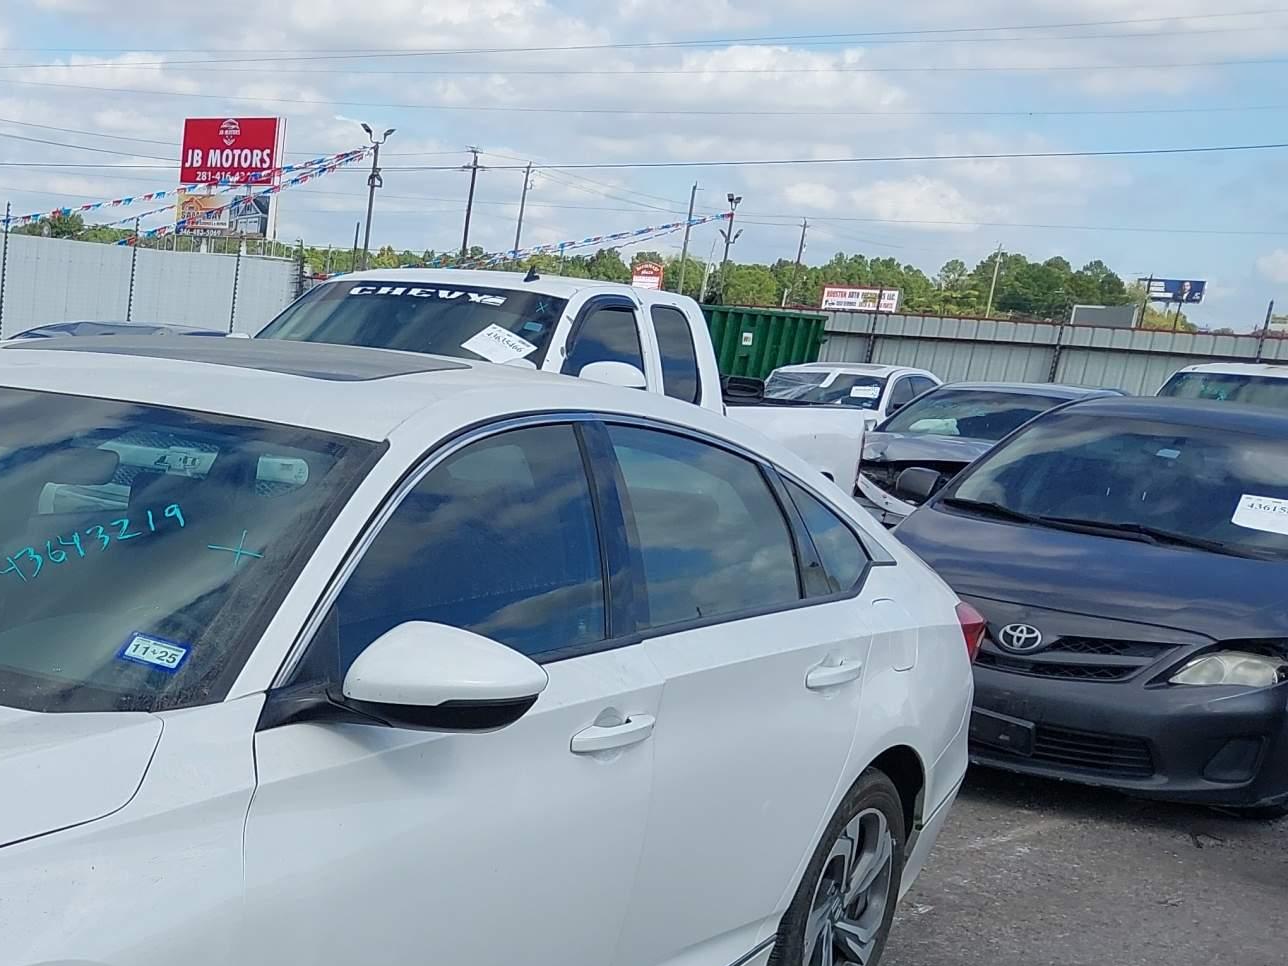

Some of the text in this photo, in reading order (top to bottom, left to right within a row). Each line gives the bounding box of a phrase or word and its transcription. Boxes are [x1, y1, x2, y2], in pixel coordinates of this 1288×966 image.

[185, 149, 271, 168] JB MOTORS
[349, 286, 507, 306] CHEVY
